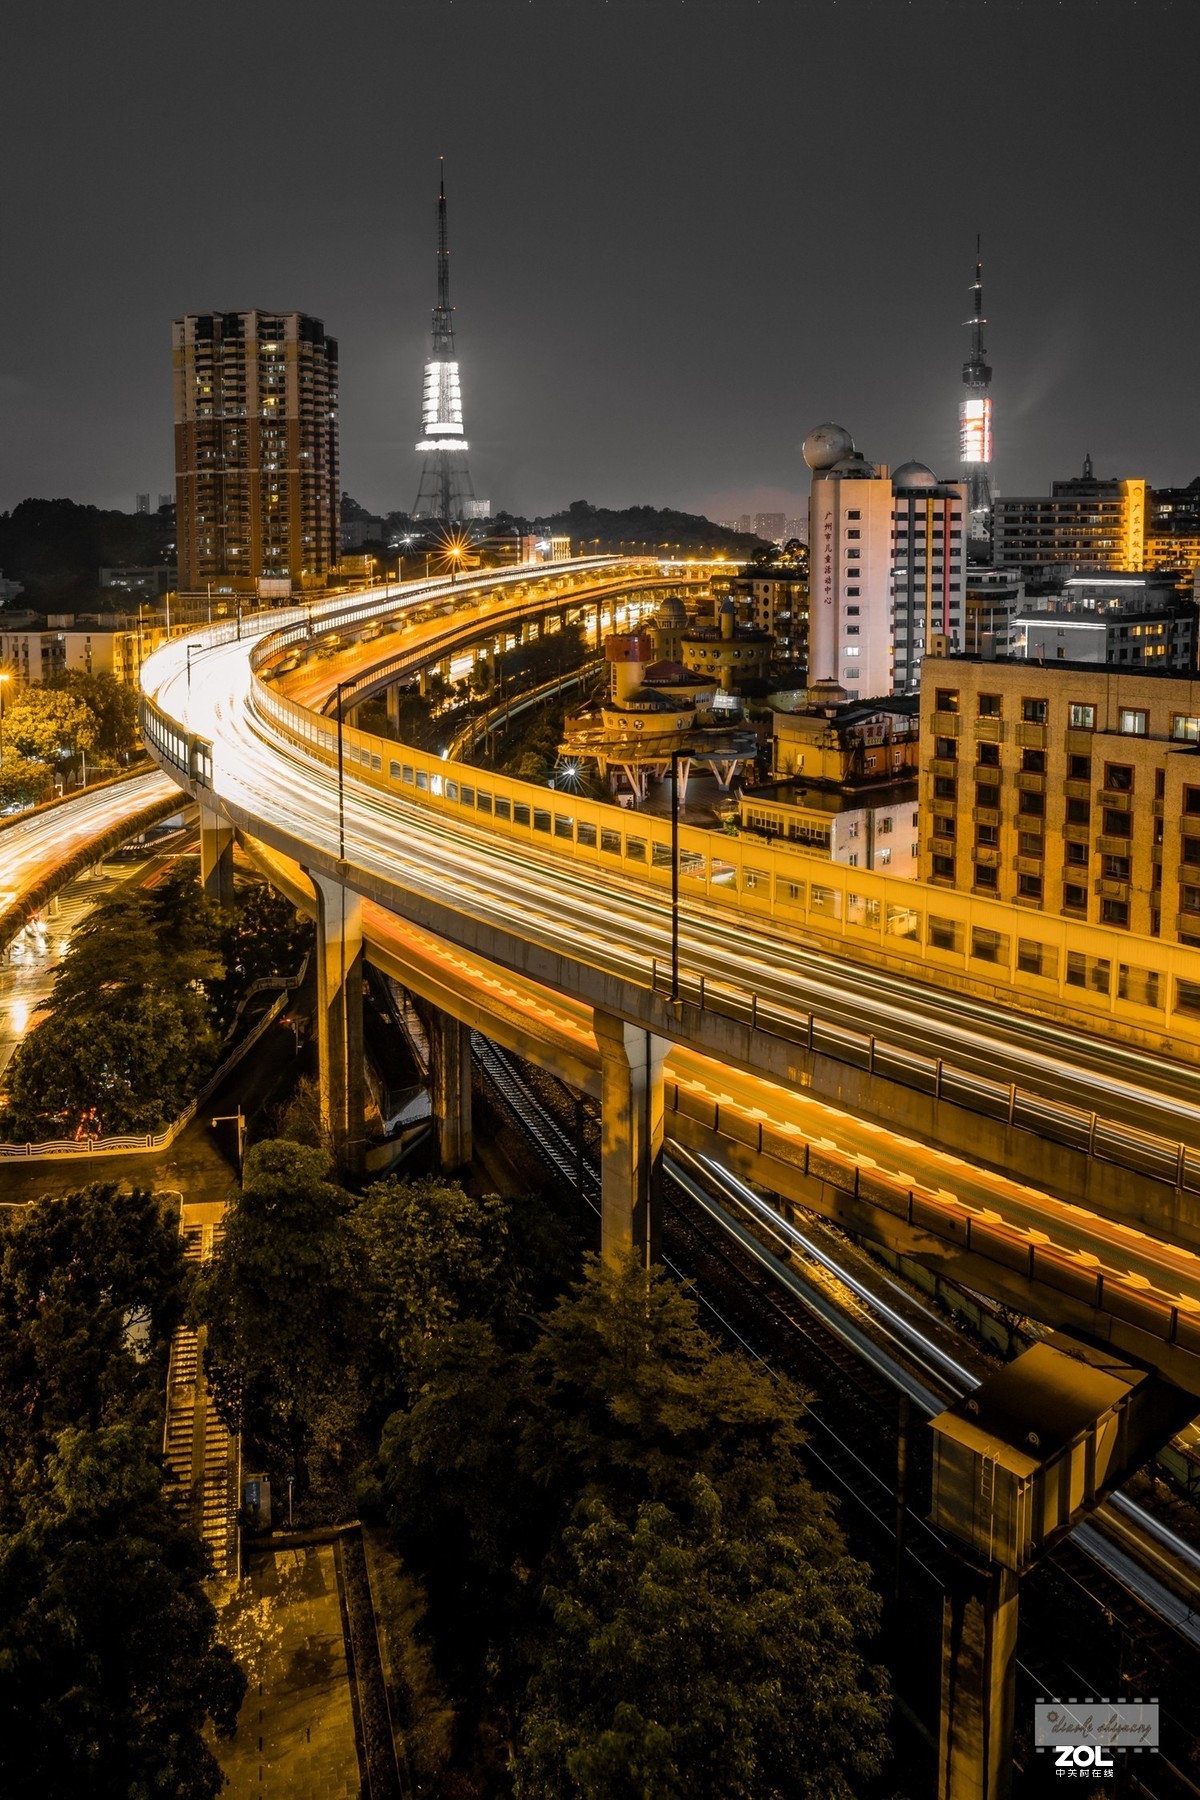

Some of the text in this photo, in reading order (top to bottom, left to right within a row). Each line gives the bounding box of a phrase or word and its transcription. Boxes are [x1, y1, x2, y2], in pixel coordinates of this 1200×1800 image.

[824, 511, 833, 605] 广州市儿童活动中心
